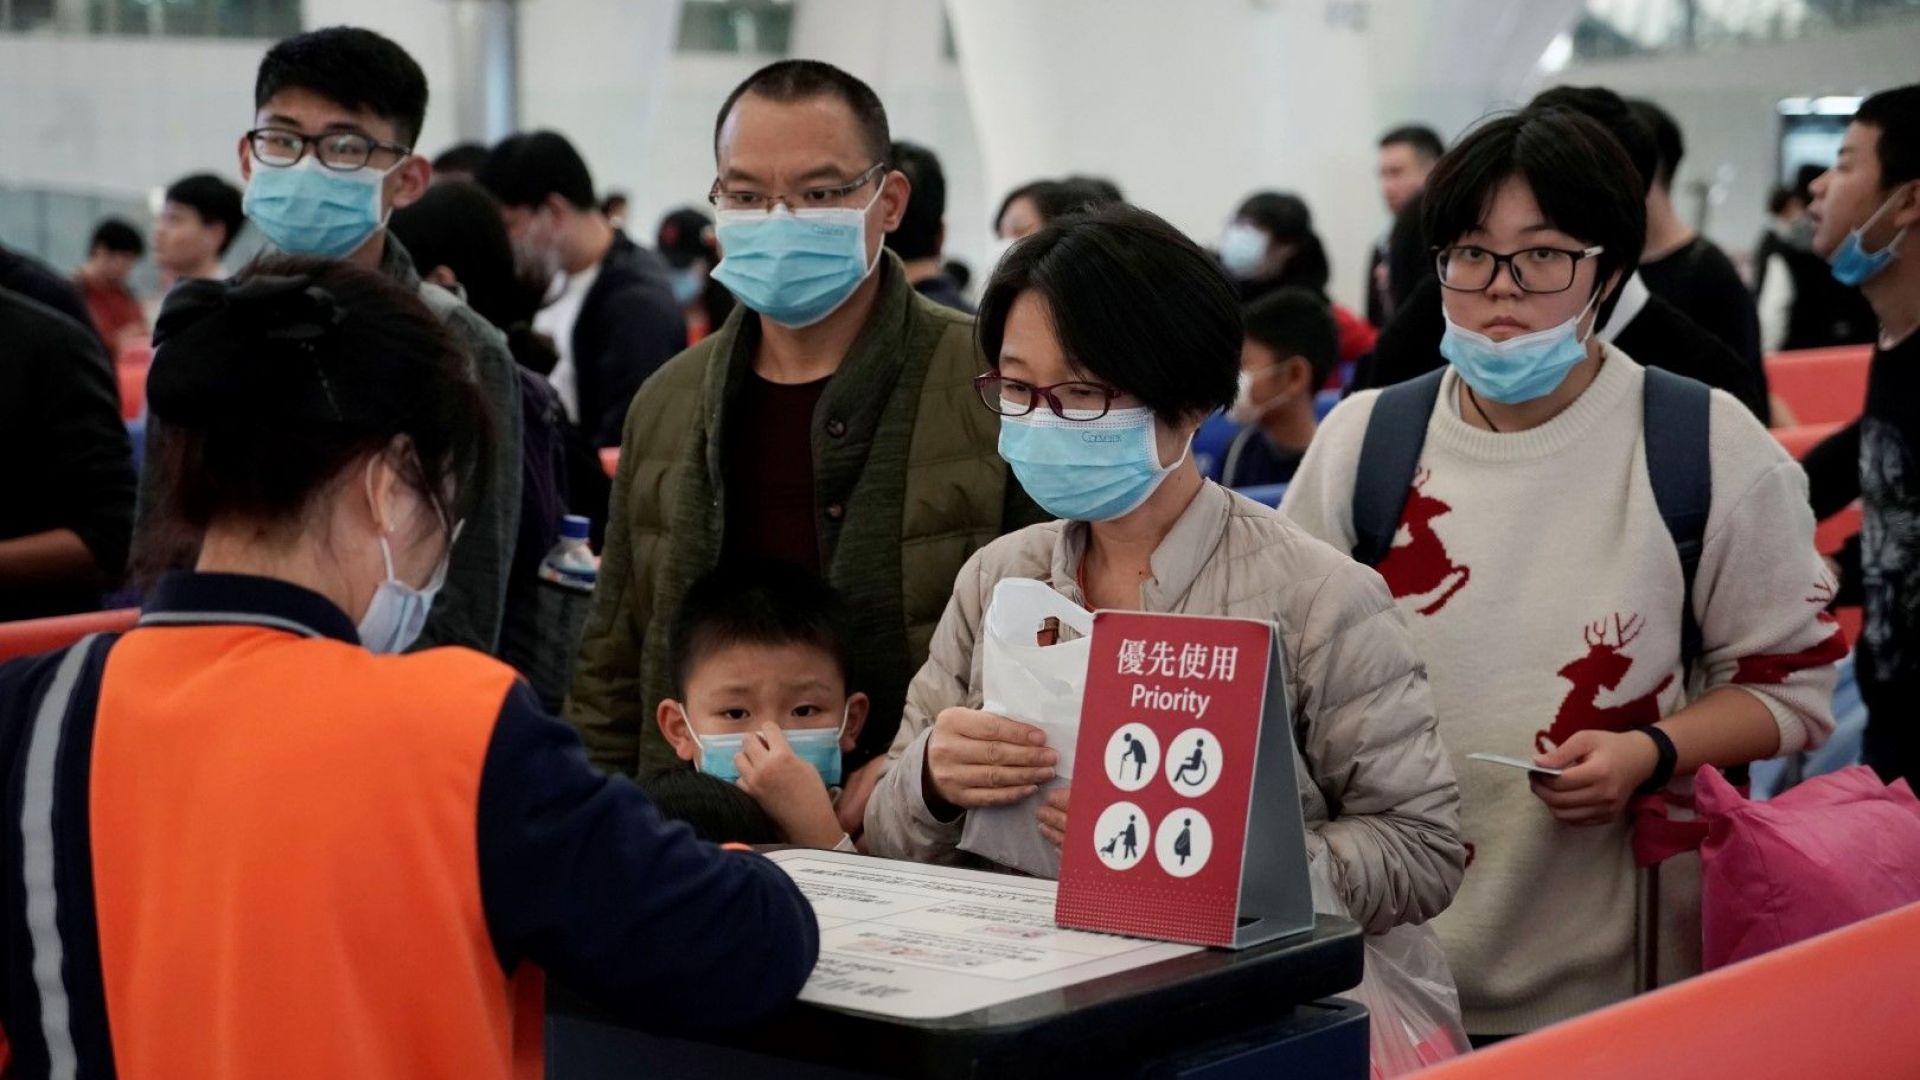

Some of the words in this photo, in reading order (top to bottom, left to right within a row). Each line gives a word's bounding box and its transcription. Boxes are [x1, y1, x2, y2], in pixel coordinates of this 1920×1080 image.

[1117, 638, 1238, 682] 優先使用
[1131, 684, 1210, 718] Priority
